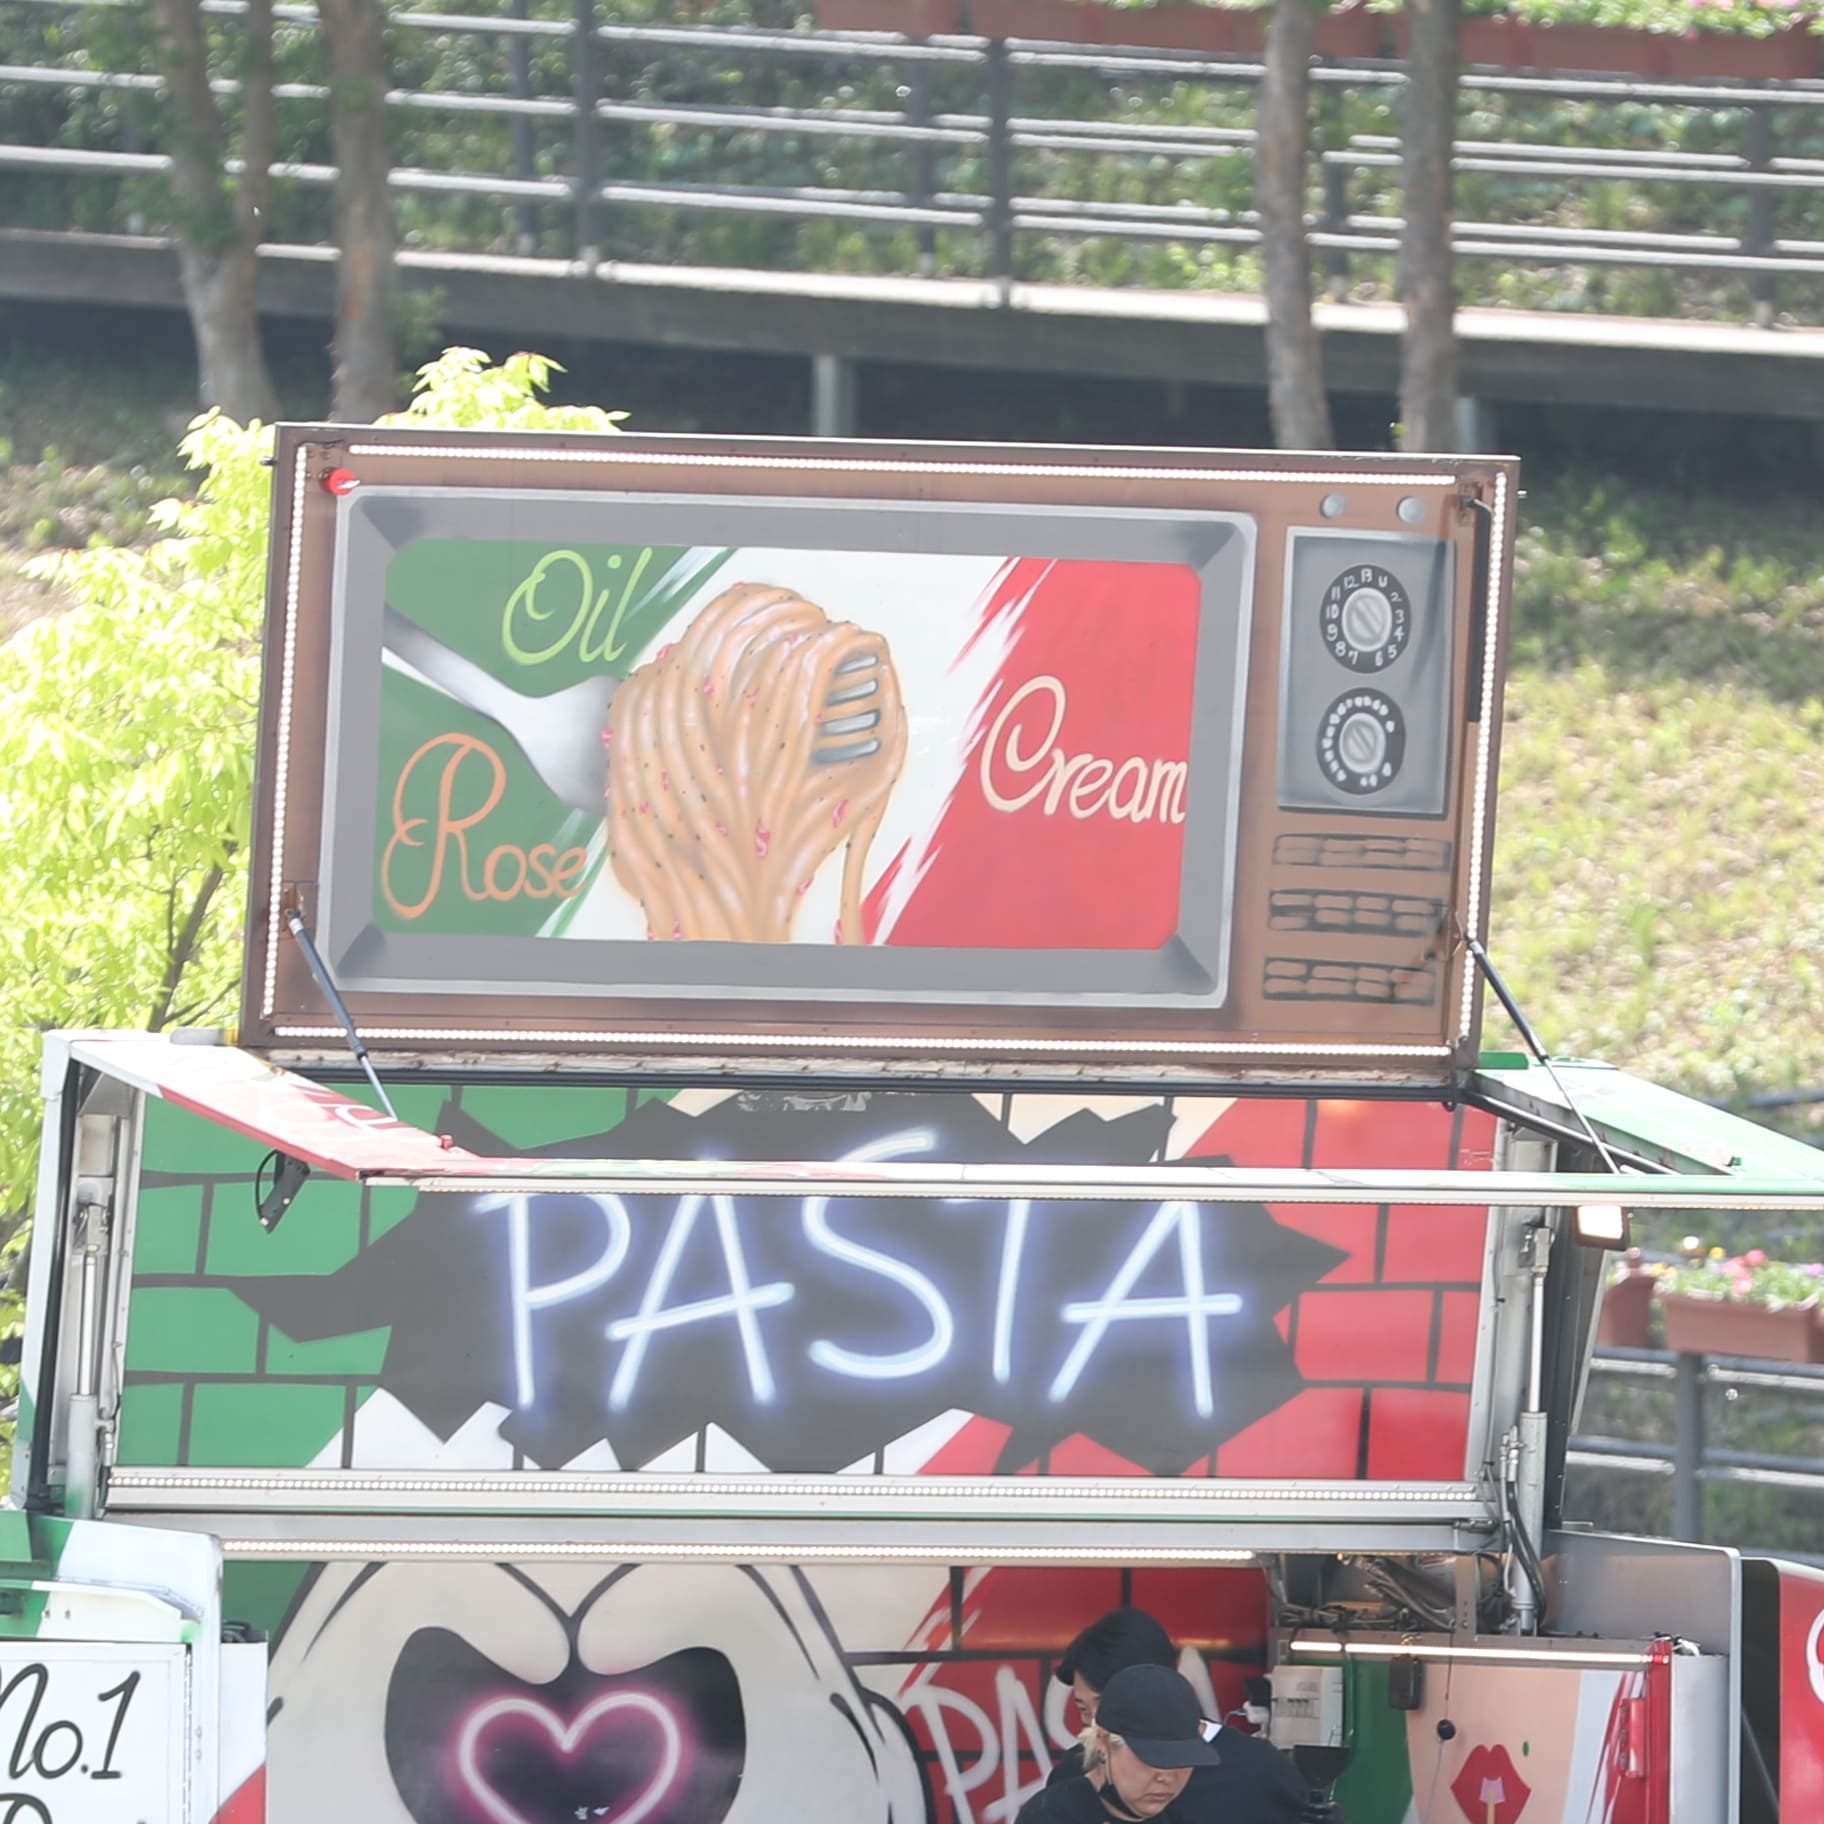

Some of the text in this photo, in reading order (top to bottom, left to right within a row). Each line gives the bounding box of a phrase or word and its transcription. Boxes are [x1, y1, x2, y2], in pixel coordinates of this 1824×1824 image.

[1344, 575, 1360, 588] 12
[500, 547, 655, 666] Oil
[1395, 609, 1404, 623] 3
[1327, 624, 1338, 641] 9
[1394, 625, 1404, 642] 4
[1336, 641, 1346, 656] 8
[1388, 644, 1397, 659] 5
[1348, 651, 1358, 665] 7
[980, 674, 1187, 825] Cream
[380, 732, 588, 920] Rose
[473, 1127, 1245, 1419] PASTA
